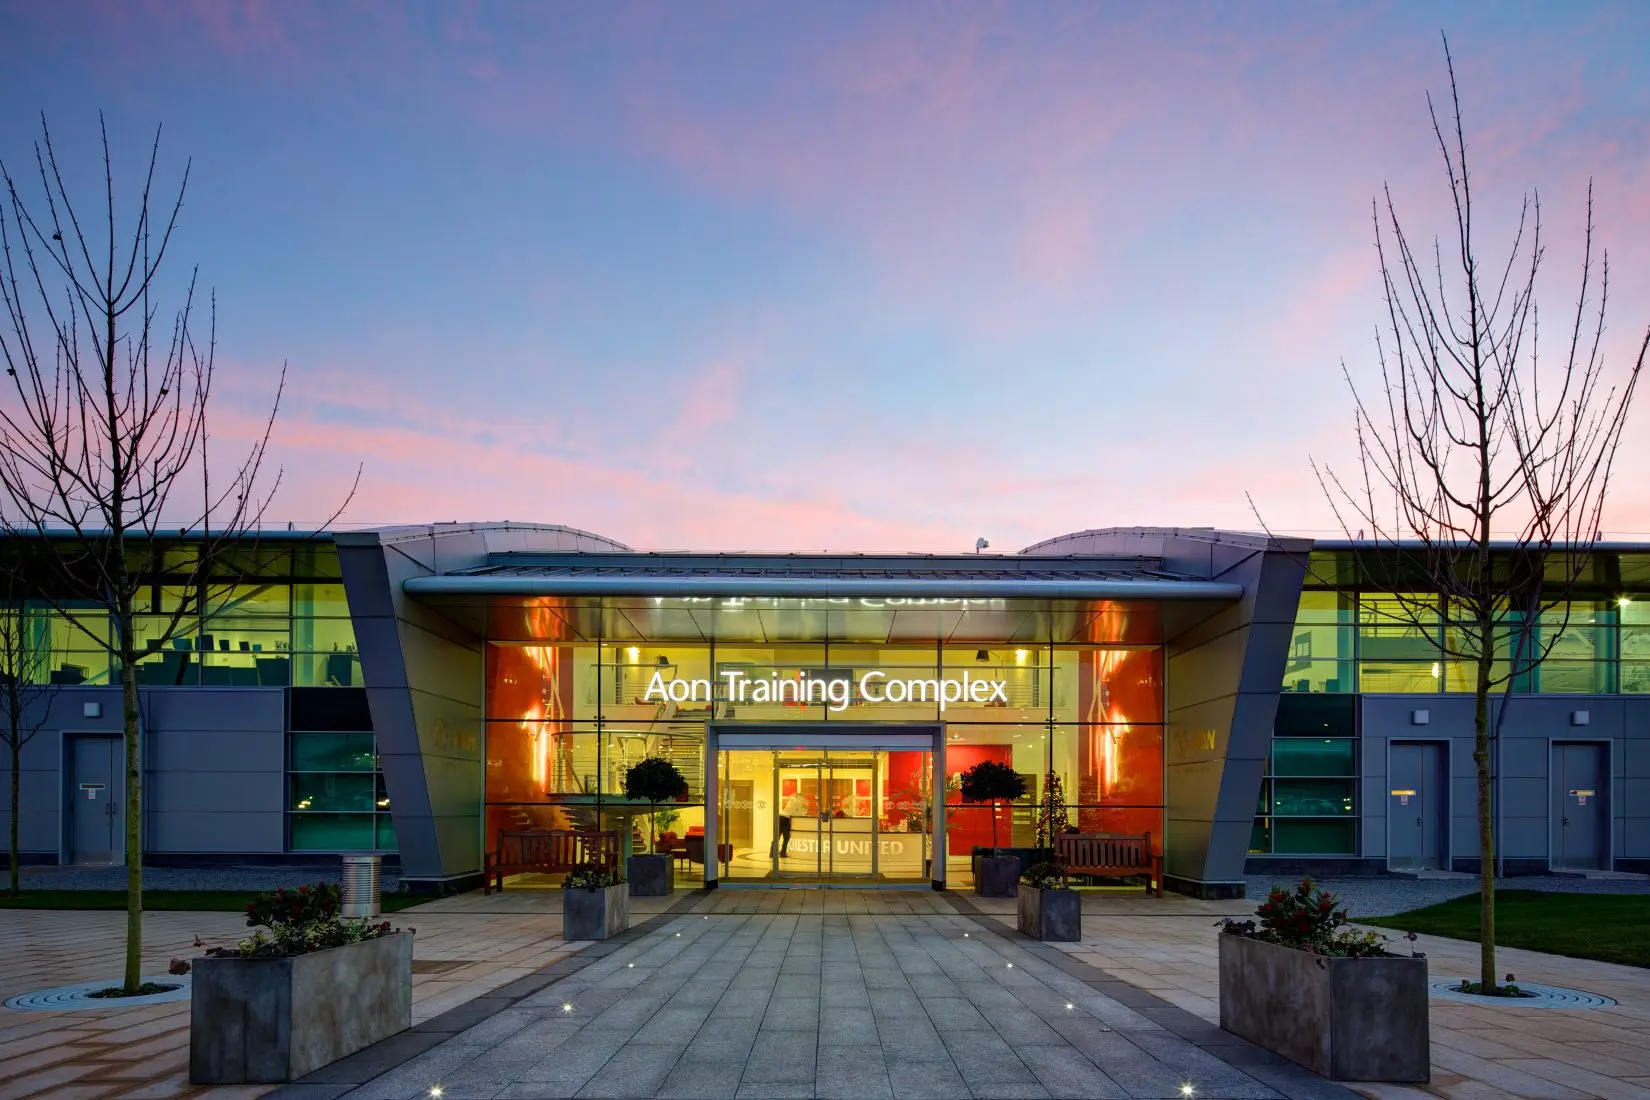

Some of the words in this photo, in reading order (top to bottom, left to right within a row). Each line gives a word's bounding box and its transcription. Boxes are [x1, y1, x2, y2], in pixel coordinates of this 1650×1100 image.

[644, 672, 711, 702] Aon
[720, 671, 849, 712] Training
[860, 671, 1008, 712] Complex
